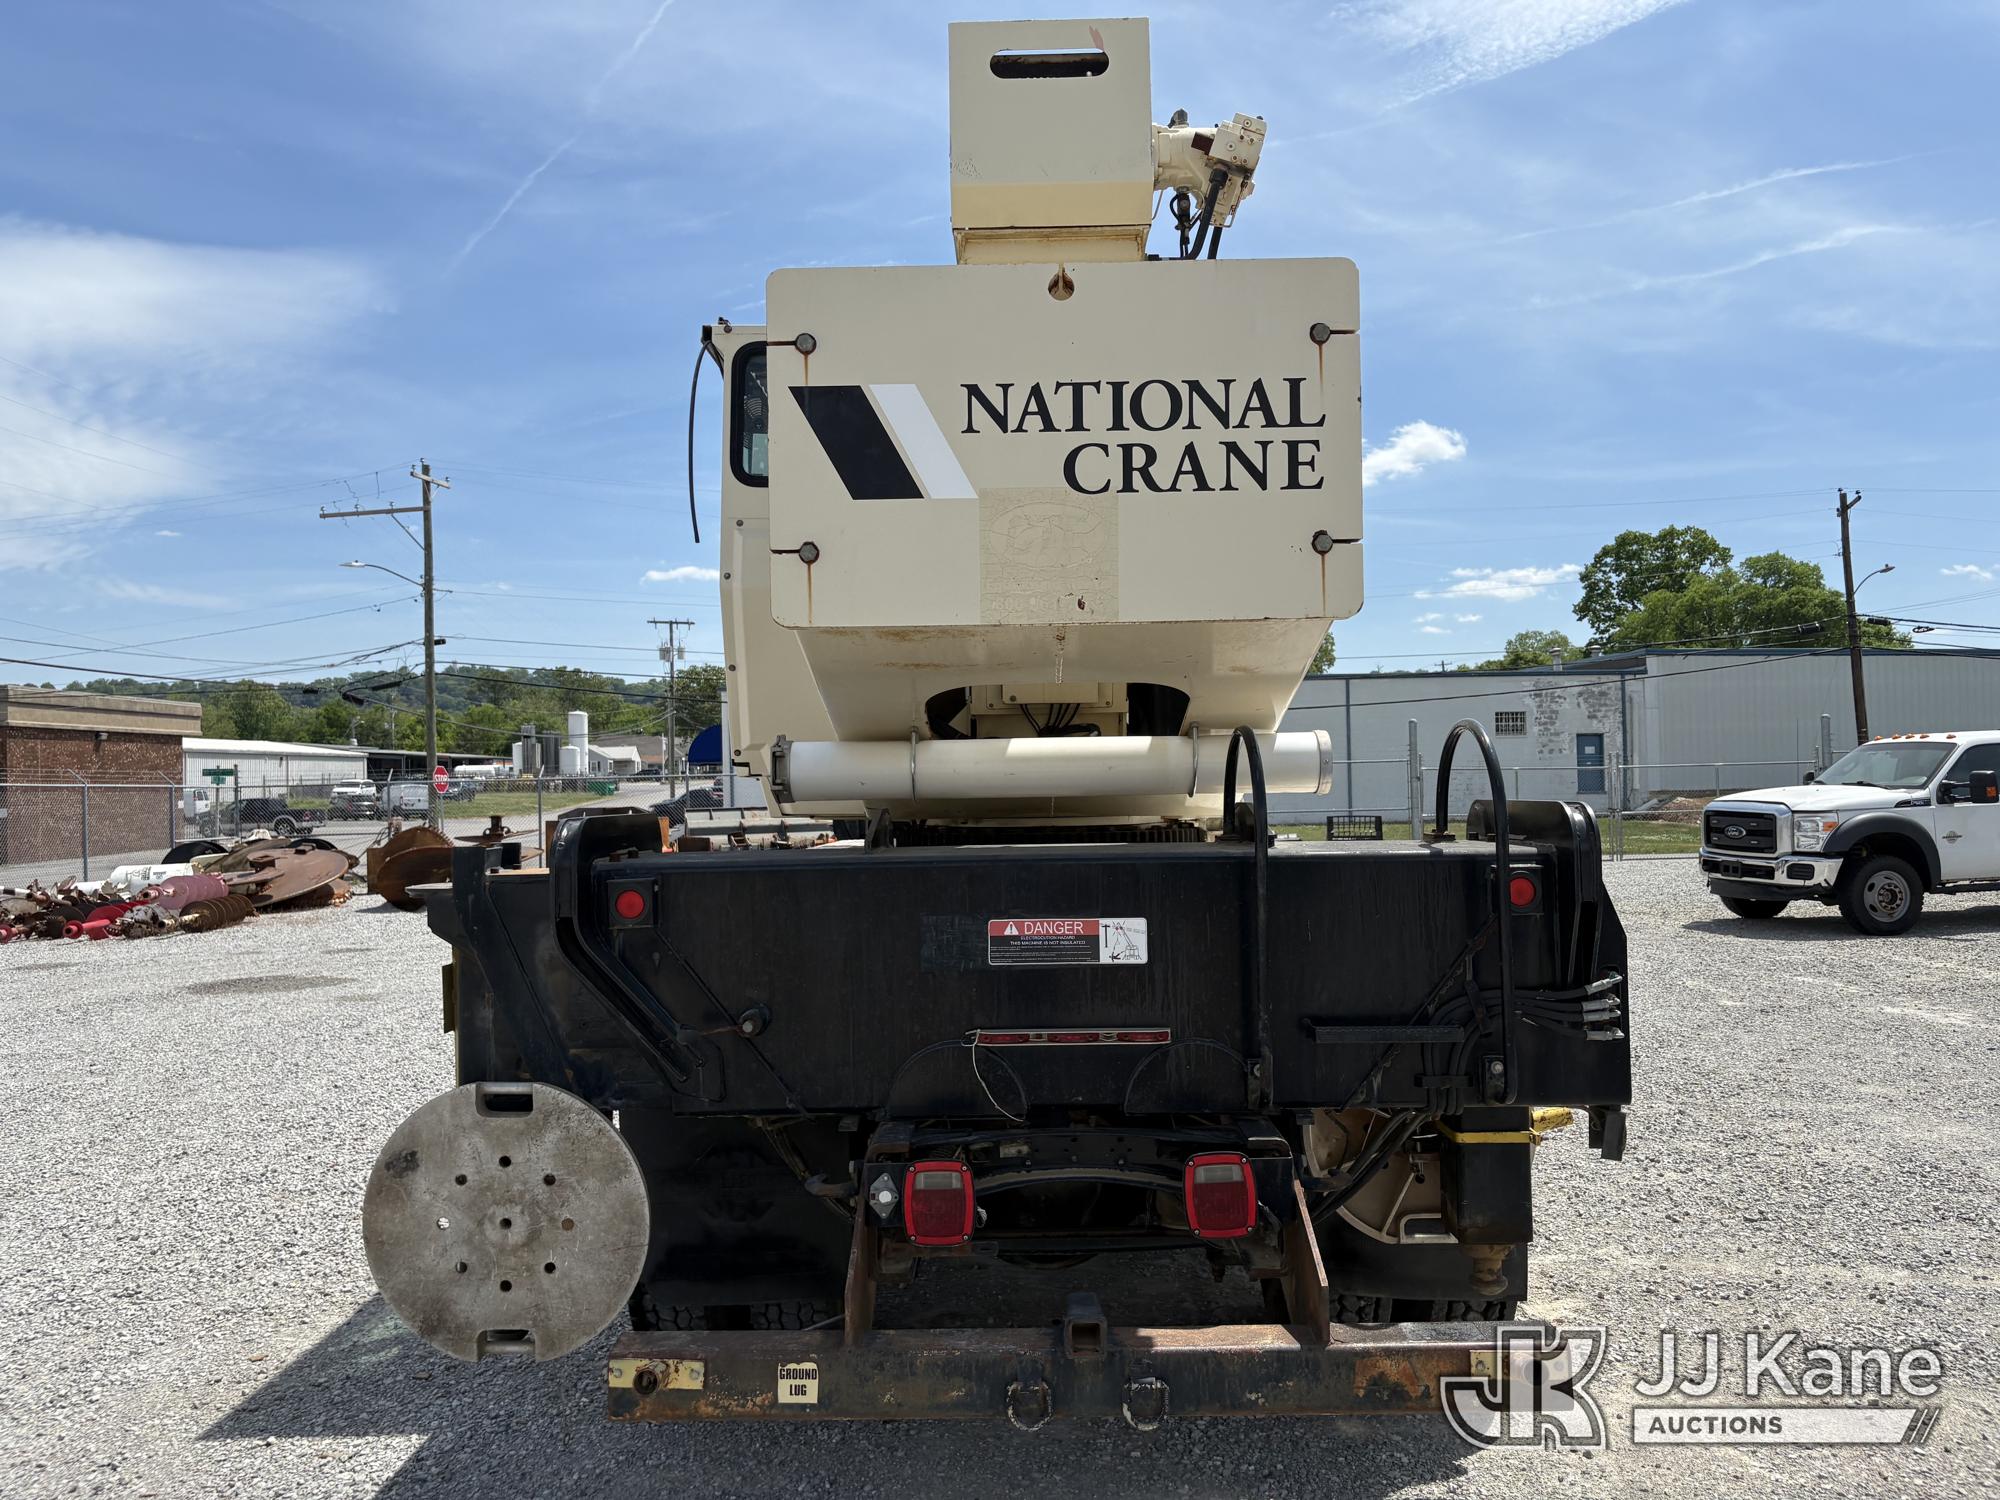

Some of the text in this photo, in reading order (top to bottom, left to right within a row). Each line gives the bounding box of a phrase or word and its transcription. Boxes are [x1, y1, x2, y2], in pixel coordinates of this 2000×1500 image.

[960, 377, 1327, 434] NATIONAL
[1062, 439, 1325, 495] CRANE
[435, 774, 448, 784] STOP
[1024, 921, 1084, 935] DANGER
[779, 1368, 817, 1380] GROUND
[789, 1384, 807, 1396] LUG
